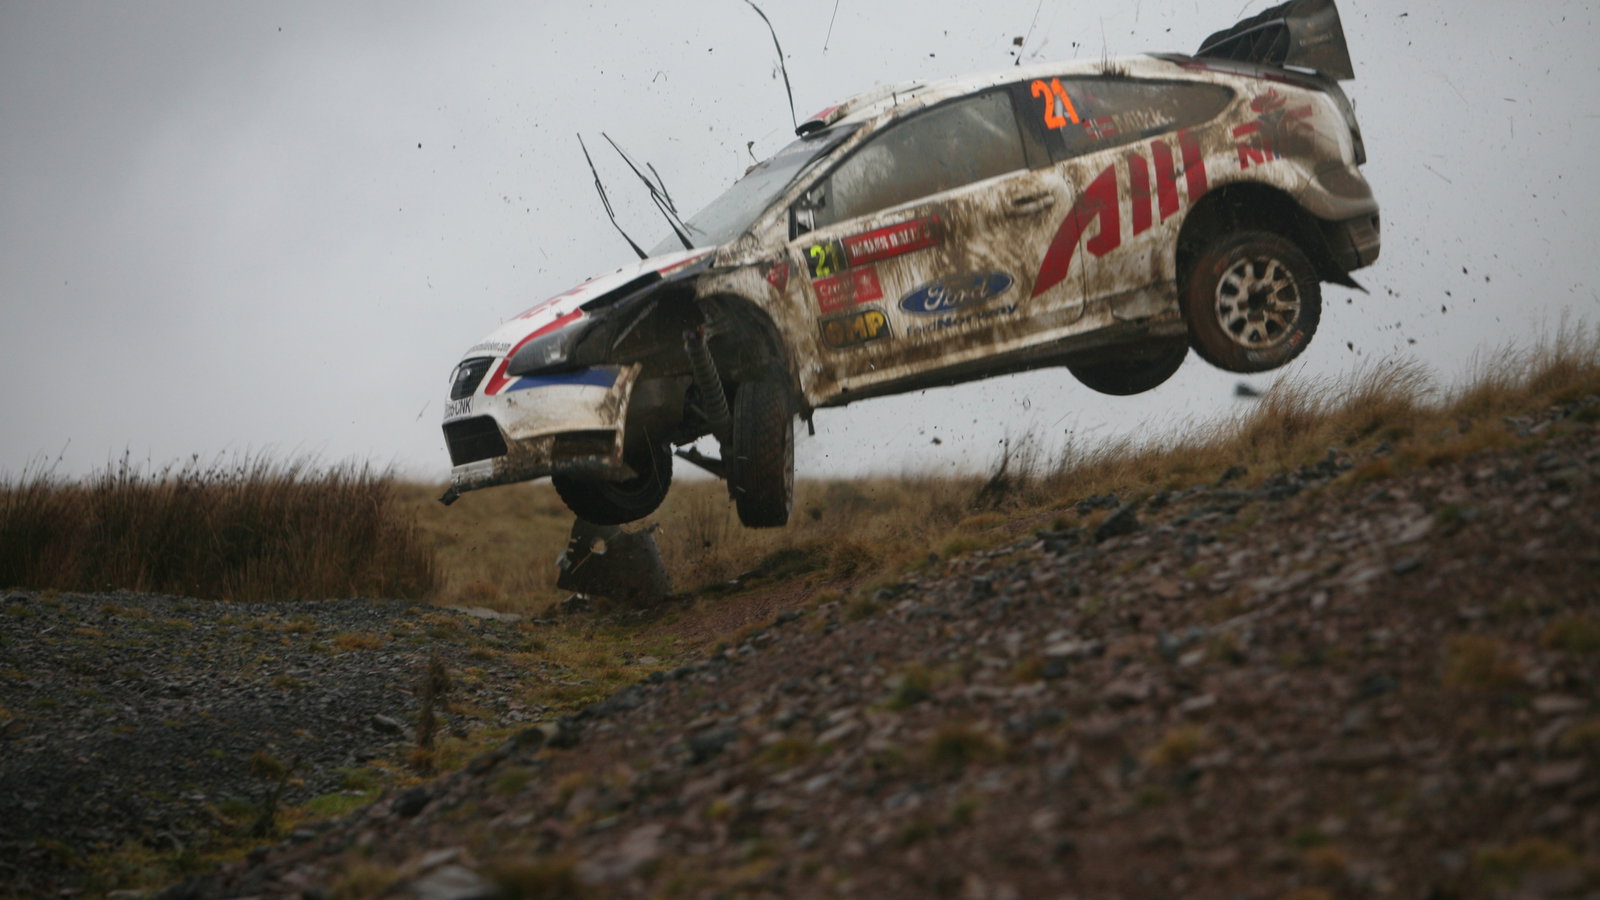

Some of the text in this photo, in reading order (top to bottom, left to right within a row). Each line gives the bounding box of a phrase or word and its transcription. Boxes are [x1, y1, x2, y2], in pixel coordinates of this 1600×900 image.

[1031, 78, 1079, 128] 21
[810, 239, 840, 277] 21
[924, 279, 988, 311] Ford
